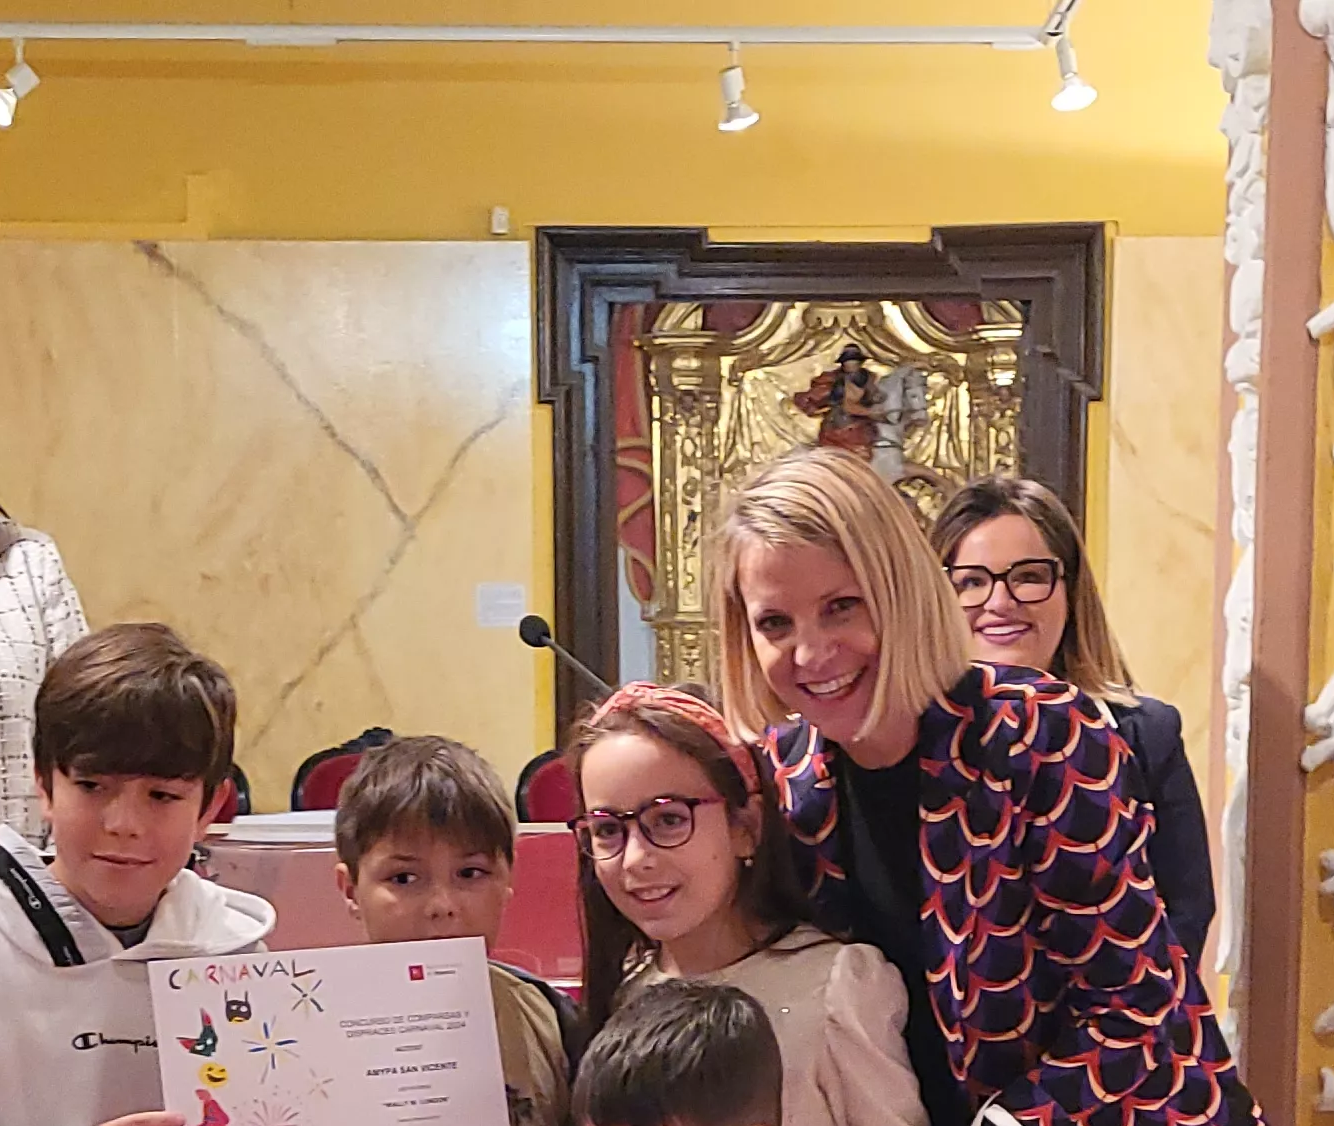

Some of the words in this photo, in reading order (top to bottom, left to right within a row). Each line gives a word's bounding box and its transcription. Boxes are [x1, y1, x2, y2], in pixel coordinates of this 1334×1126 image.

[169, 959, 316, 990] CARNAVAL
[400, 1064, 418, 1073] SAN
[421, 1061, 458, 1072] VICENTE
